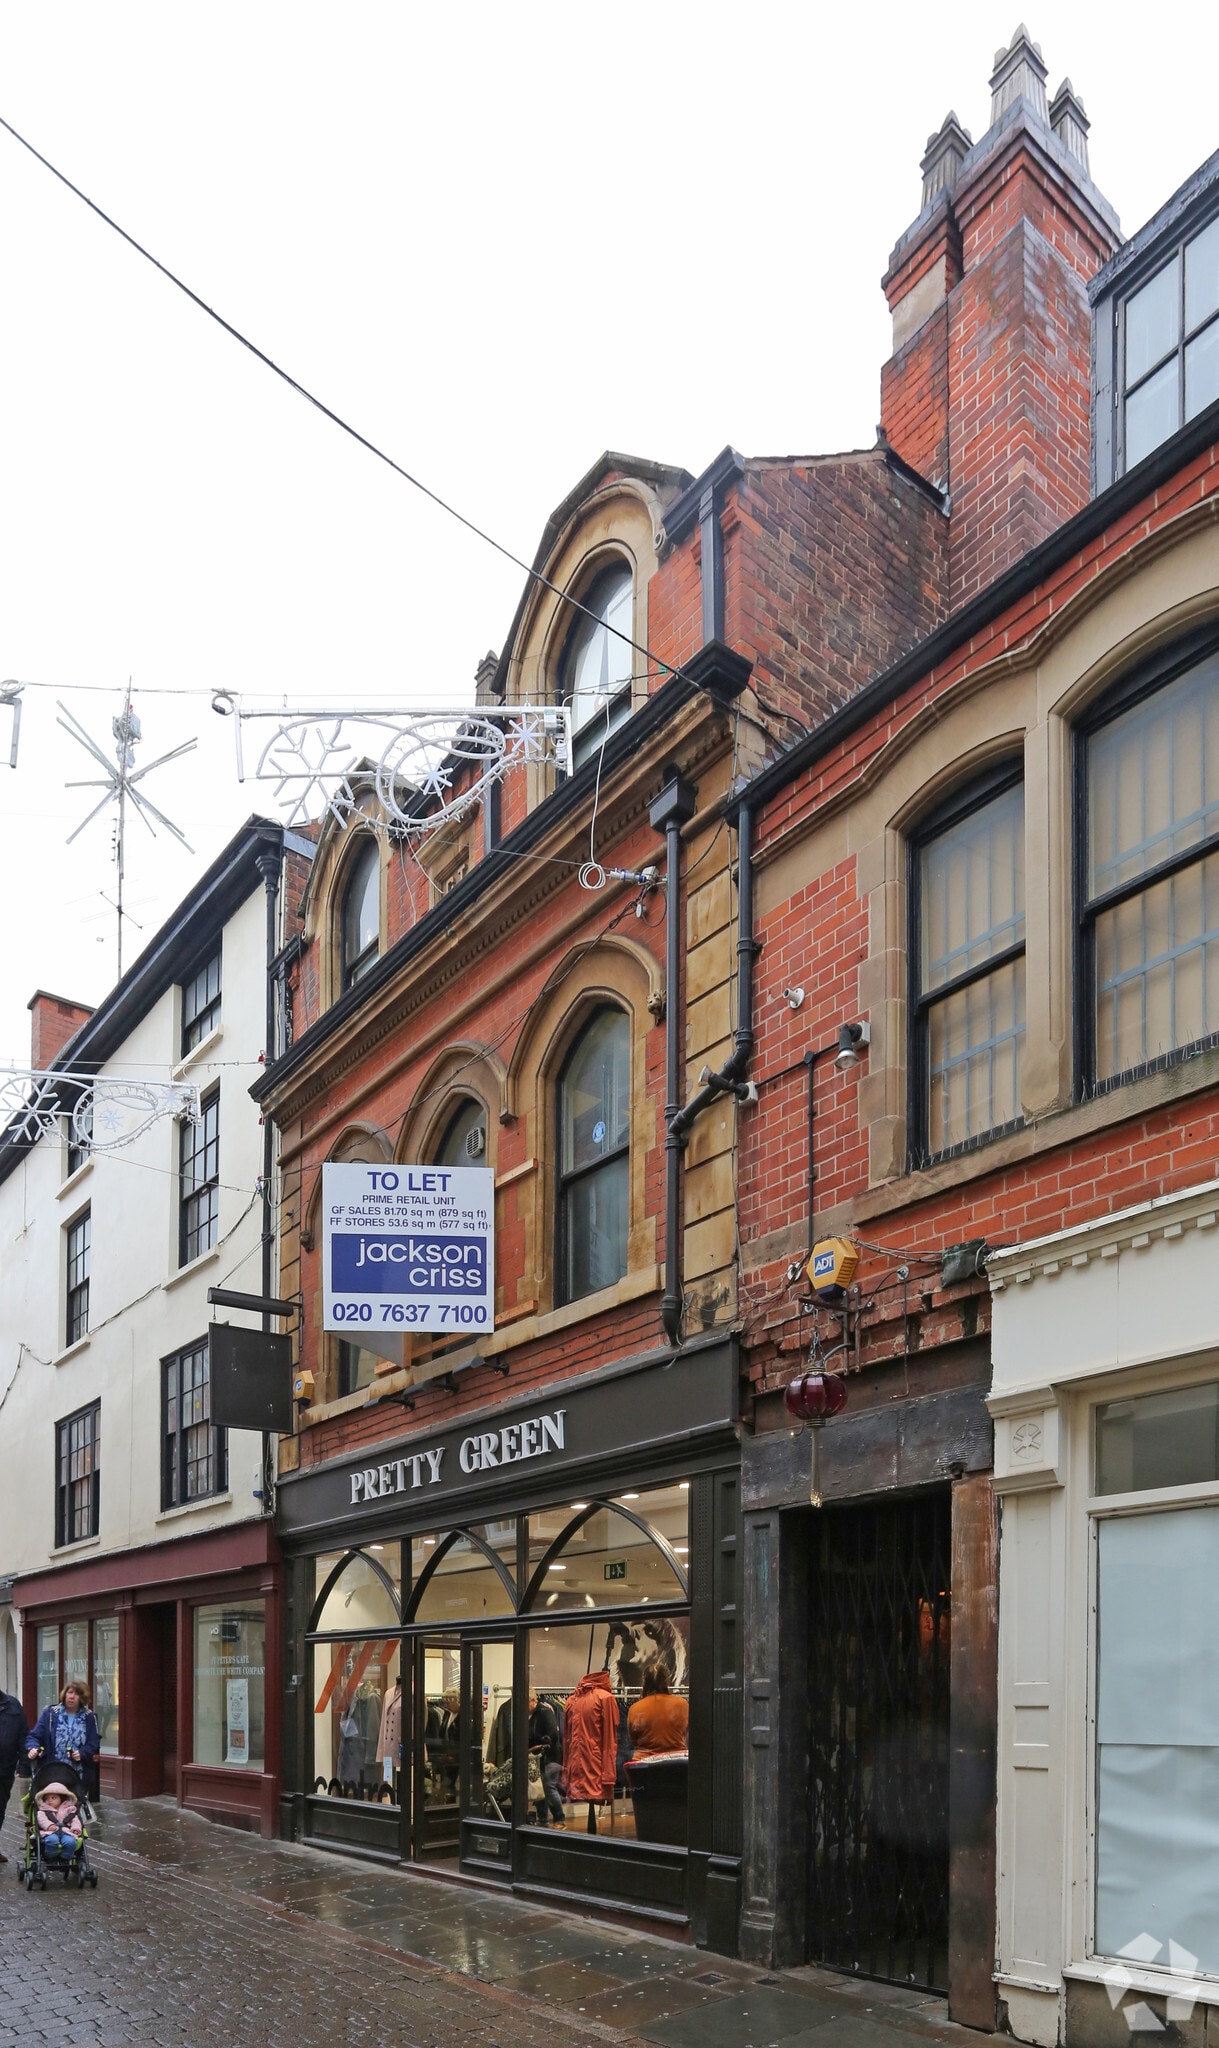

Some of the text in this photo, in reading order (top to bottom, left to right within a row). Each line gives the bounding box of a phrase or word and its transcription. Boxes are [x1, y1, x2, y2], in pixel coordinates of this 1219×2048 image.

[367, 1172, 451, 1192] TO LET
[362, 1195, 456, 1205] PRIME RETAIL UNIT
[331, 1206, 345, 1215] GF
[348, 1206, 381, 1215] SALES
[384, 1207, 408, 1216] 81.70
[410, 1210, 423, 1218] sq
[438, 1209, 458, 1218] (879
[461, 1210, 474, 1219] sq
[476, 1209, 487, 1219] ft)
[330, 1217, 342, 1226] FF
[345, 1218, 385, 1227] STORES
[388, 1219, 409, 1227] 53.6
[411, 1221, 424, 1229] sq
[439, 1220, 460, 1230] (577
[463, 1222, 475, 1231] sq
[478, 1221, 488, 1230] ft)
[356, 1238, 482, 1267] jackson
[815, 1255, 834, 1272] ADT
[409, 1263, 482, 1288] criss
[332, 1303, 487, 1324] 020 7637 7100
[349, 1409, 567, 1504] PRETTY GREEN
[64, 1659, 88, 1673] MOVING
[236, 1655, 249, 1664] GATE
